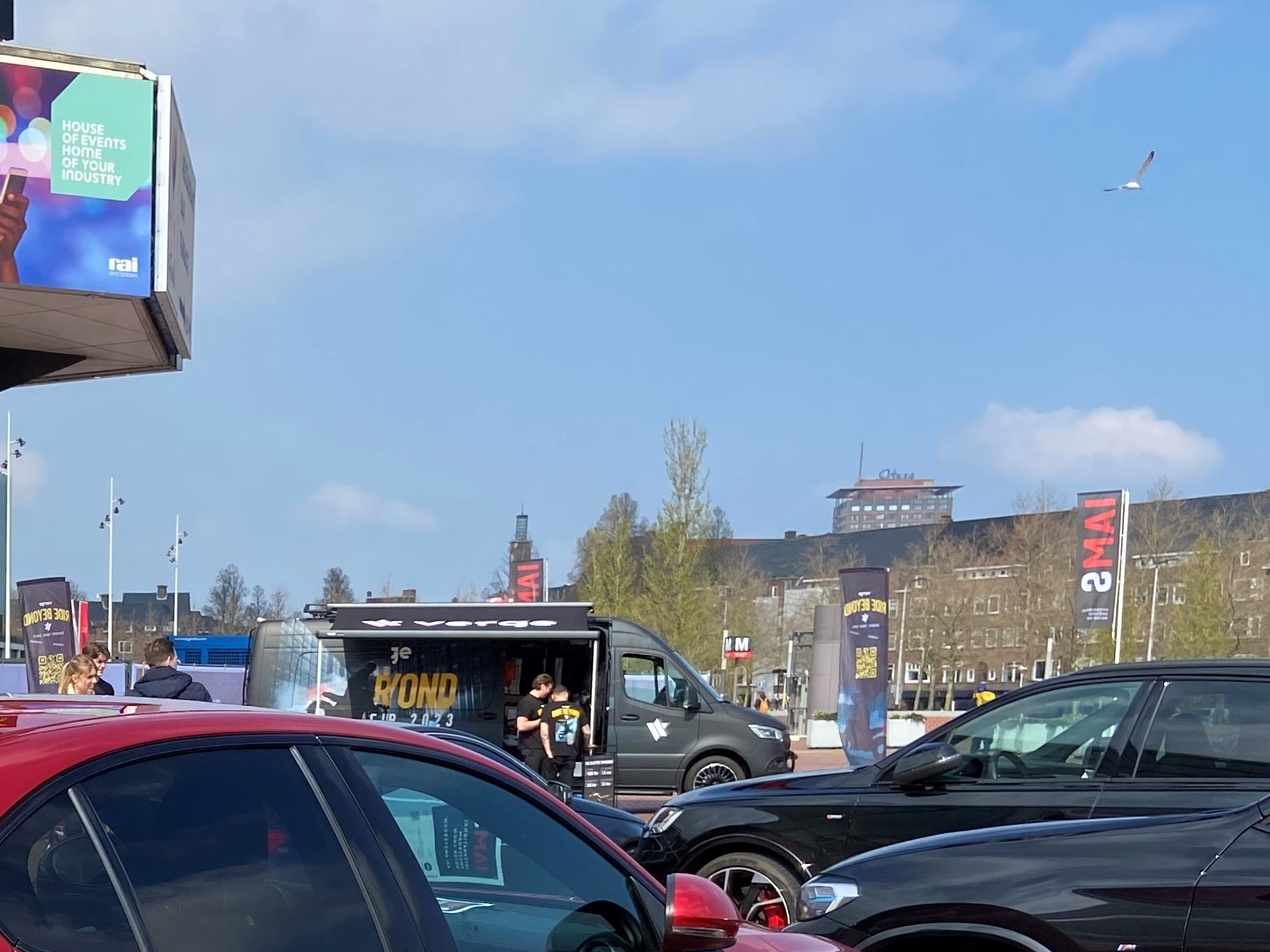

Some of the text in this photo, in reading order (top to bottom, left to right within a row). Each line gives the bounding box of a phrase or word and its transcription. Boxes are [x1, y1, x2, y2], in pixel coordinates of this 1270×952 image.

[62, 119, 105, 136] HOUSE
[62, 132, 127, 151] OF EVENTS
[62, 144, 103, 160] HOME
[62, 157, 116, 174] OF YOUR
[62, 169, 123, 187] INDUSTRY
[109, 257, 138, 273] rai
[413, 619, 558, 628] verge
[735, 637, 749, 652] M
